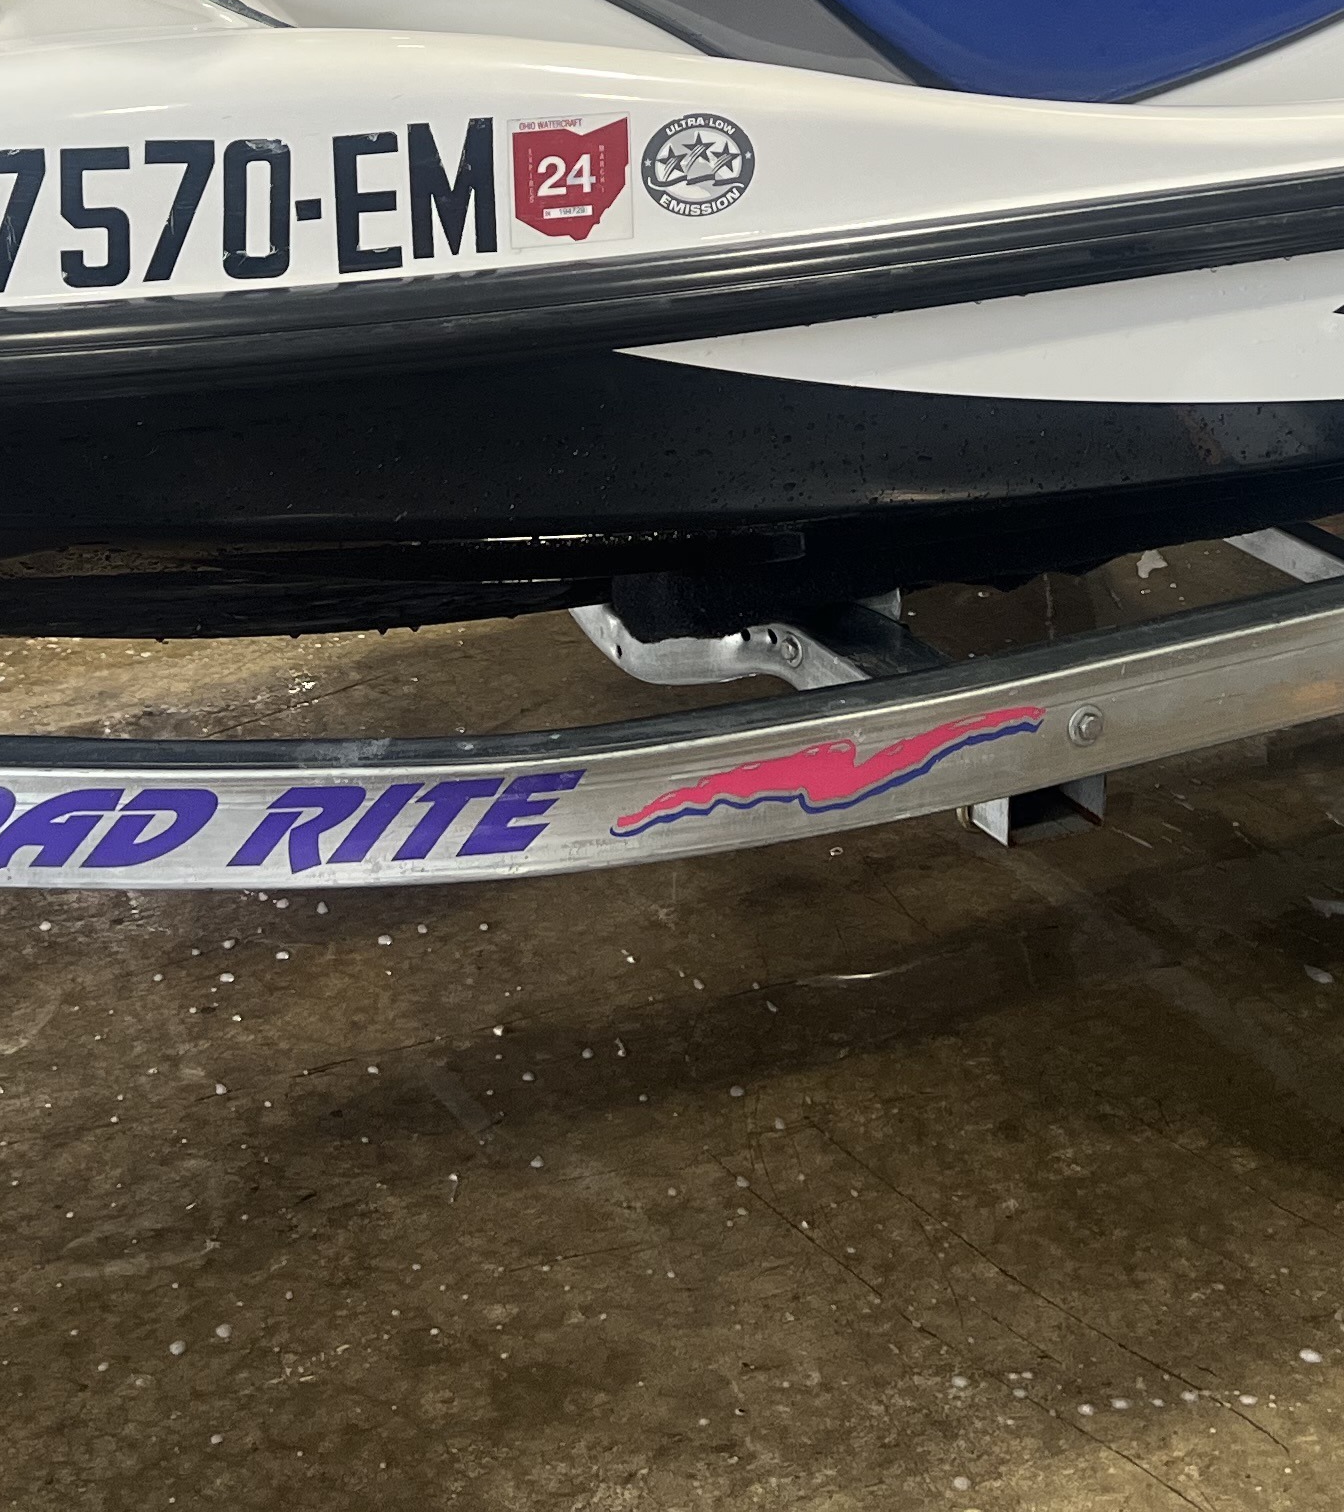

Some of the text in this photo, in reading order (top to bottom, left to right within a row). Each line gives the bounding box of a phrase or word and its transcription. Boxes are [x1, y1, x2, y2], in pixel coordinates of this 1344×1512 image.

[519, 118, 583, 130] OHIO WATERCRAFT
[537, 154, 596, 197] 24
[659, 188, 741, 216] EMISSION
[226, 769, 586, 875] RITE
